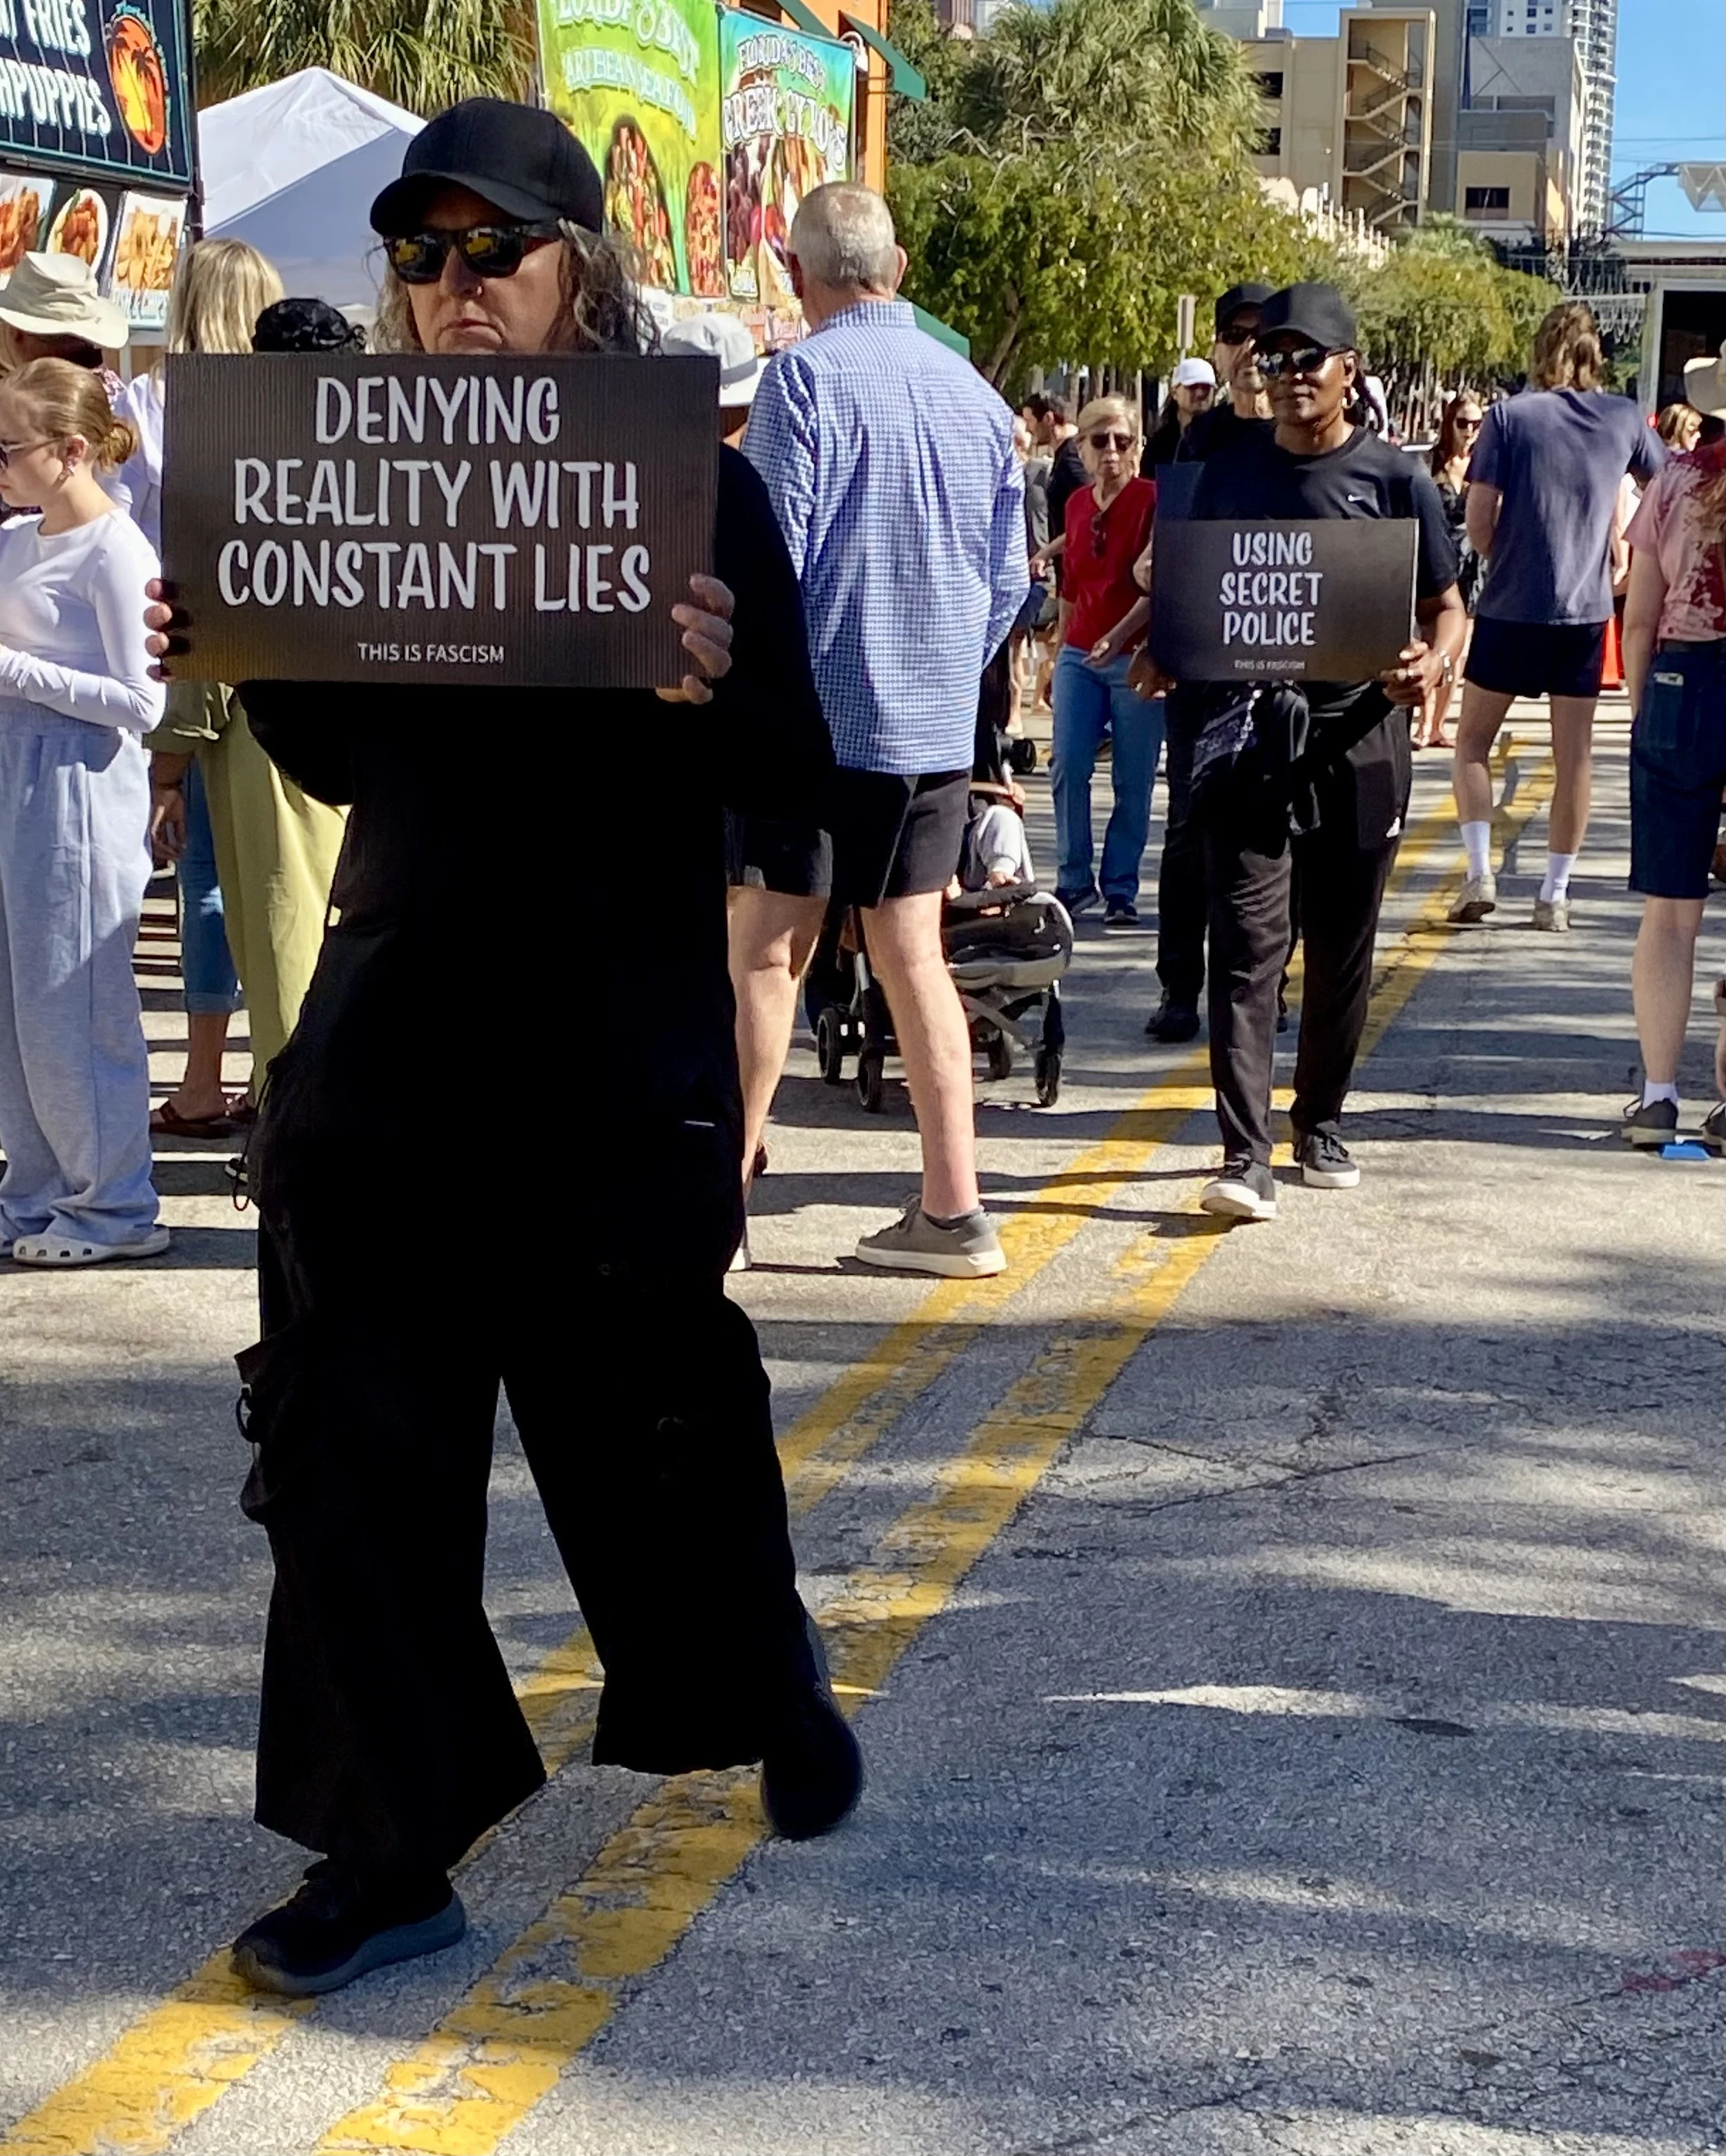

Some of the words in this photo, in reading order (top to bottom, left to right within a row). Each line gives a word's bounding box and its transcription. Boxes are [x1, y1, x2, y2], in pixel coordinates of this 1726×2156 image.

[316, 376, 560, 445] DENYING
[234, 457, 472, 528] REALITY
[489, 459, 640, 530] WITH
[1232, 532, 1312, 567] USING
[217, 538, 518, 611] CONSTANT
[534, 543, 651, 613] LIES
[1219, 572, 1323, 607] SECRET
[1223, 610, 1316, 646] POLICE
[357, 642, 400, 661] THIS
[404, 643, 422, 662] IS
[426, 643, 505, 663] FASCISM
